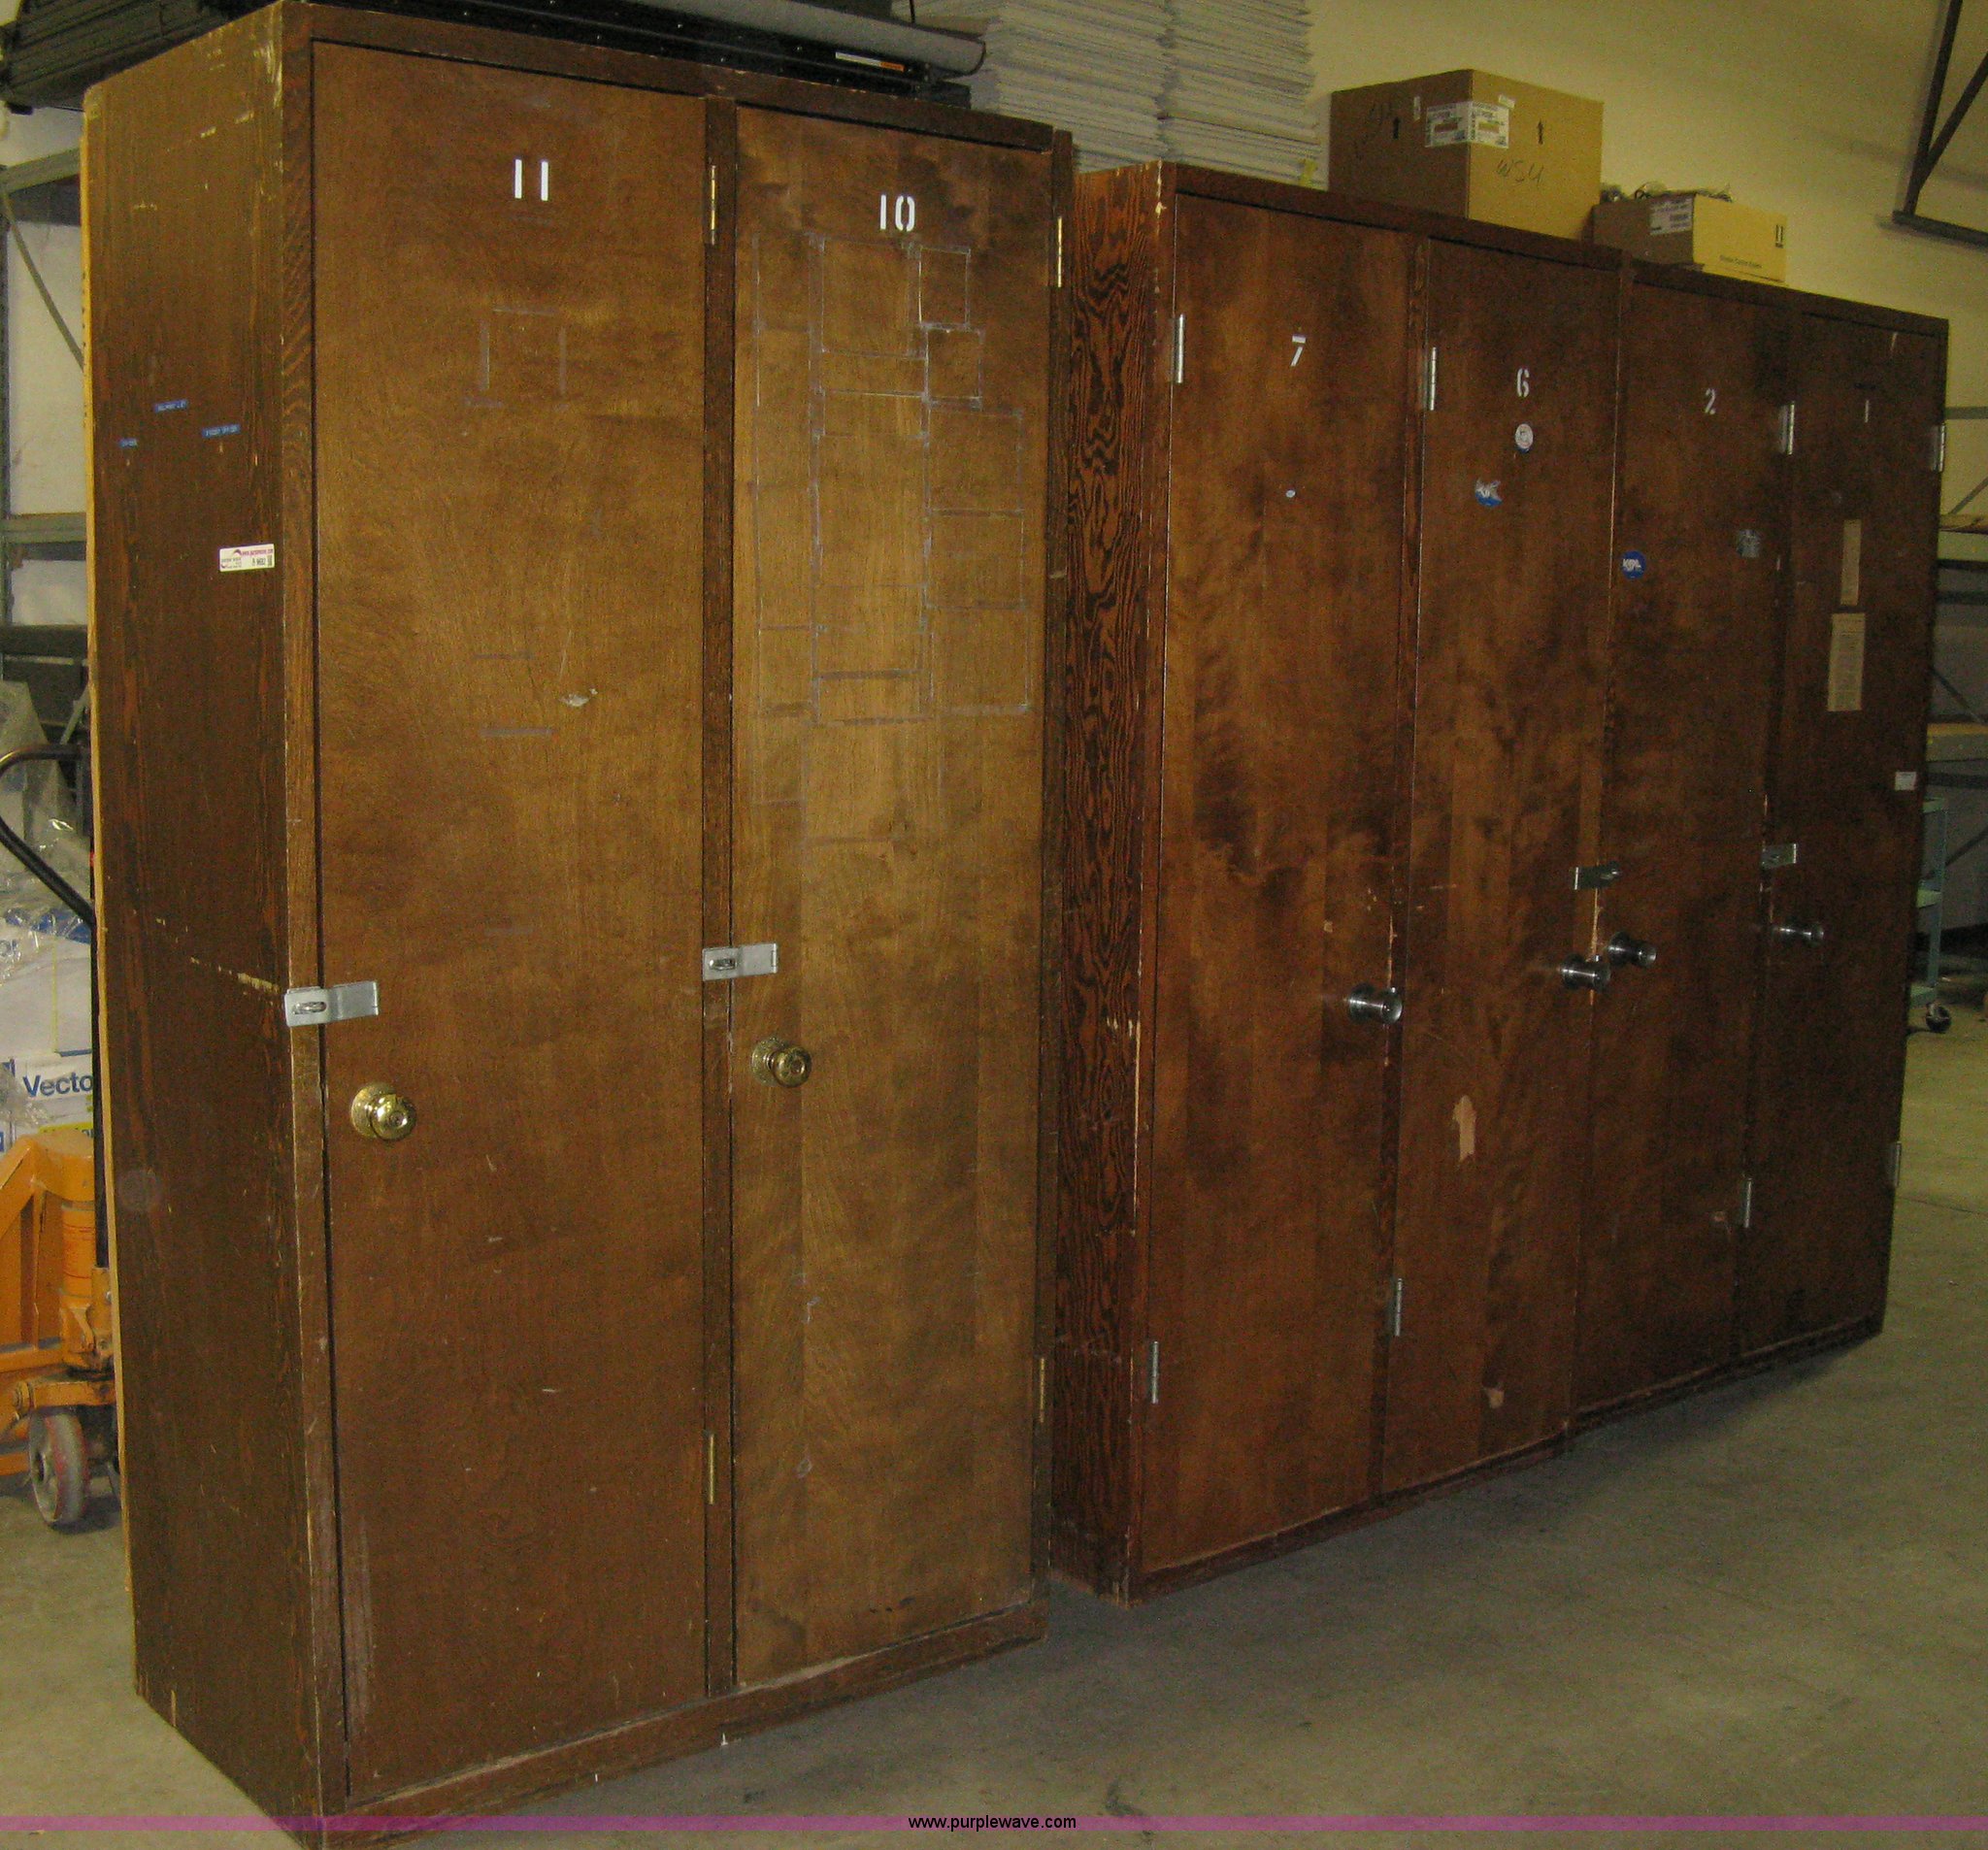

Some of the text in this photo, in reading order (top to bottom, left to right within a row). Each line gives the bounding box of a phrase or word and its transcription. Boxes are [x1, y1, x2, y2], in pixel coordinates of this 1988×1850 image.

[879, 194, 915, 232] 10
[1290, 334, 1307, 367] 7
[1516, 368, 1531, 398] 6
[1705, 388, 1716, 415] 2
